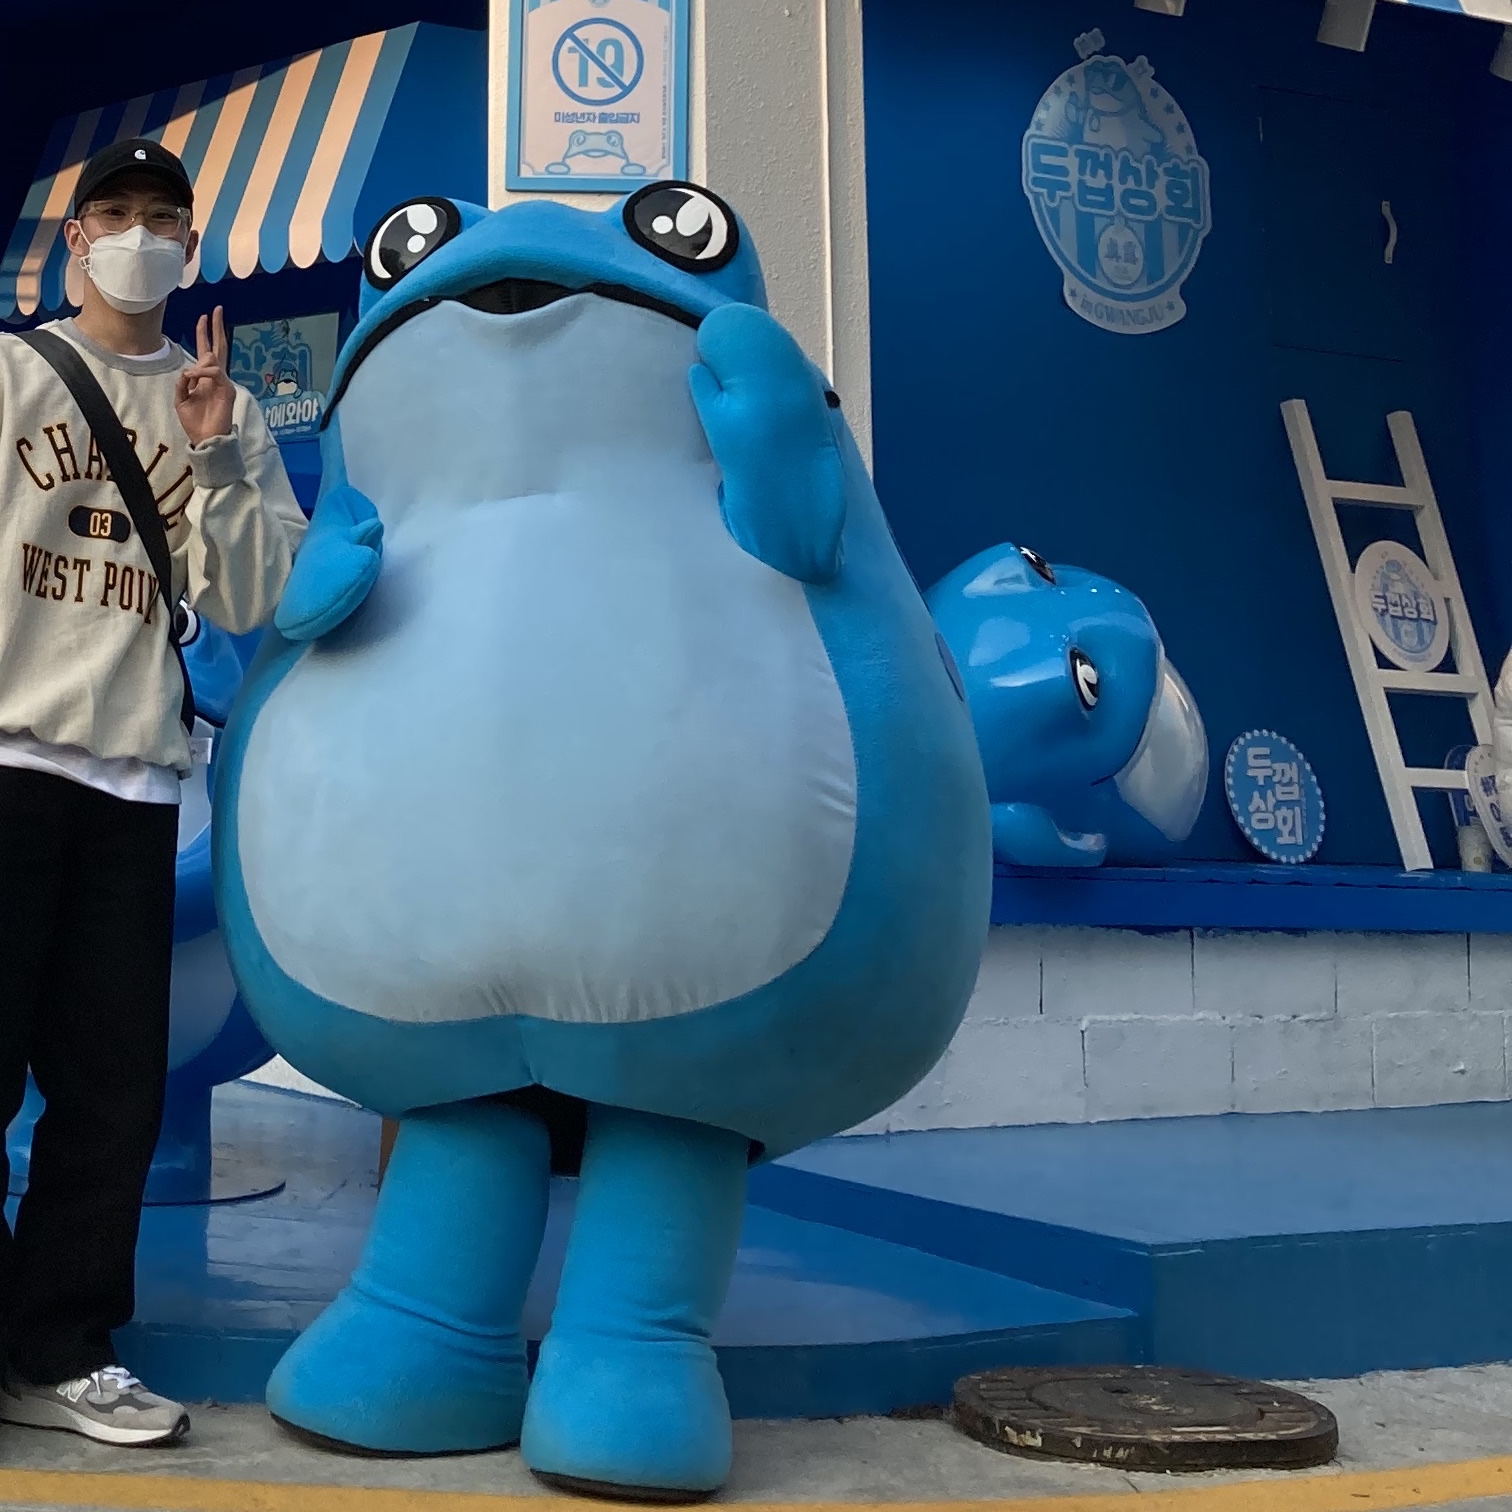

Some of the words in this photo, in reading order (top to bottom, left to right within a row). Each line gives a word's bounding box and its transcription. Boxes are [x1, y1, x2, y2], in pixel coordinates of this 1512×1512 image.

[554, 112, 597, 124] 미성년자
[598, 112, 641, 124] 출입금지
[1029, 139, 1203, 225] 두껍상회
[89, 511, 112, 537] 03
[22, 542, 91, 603] WEST
[1246, 746, 1301, 801] 두껍
[1247, 789, 1304, 846] 상회
